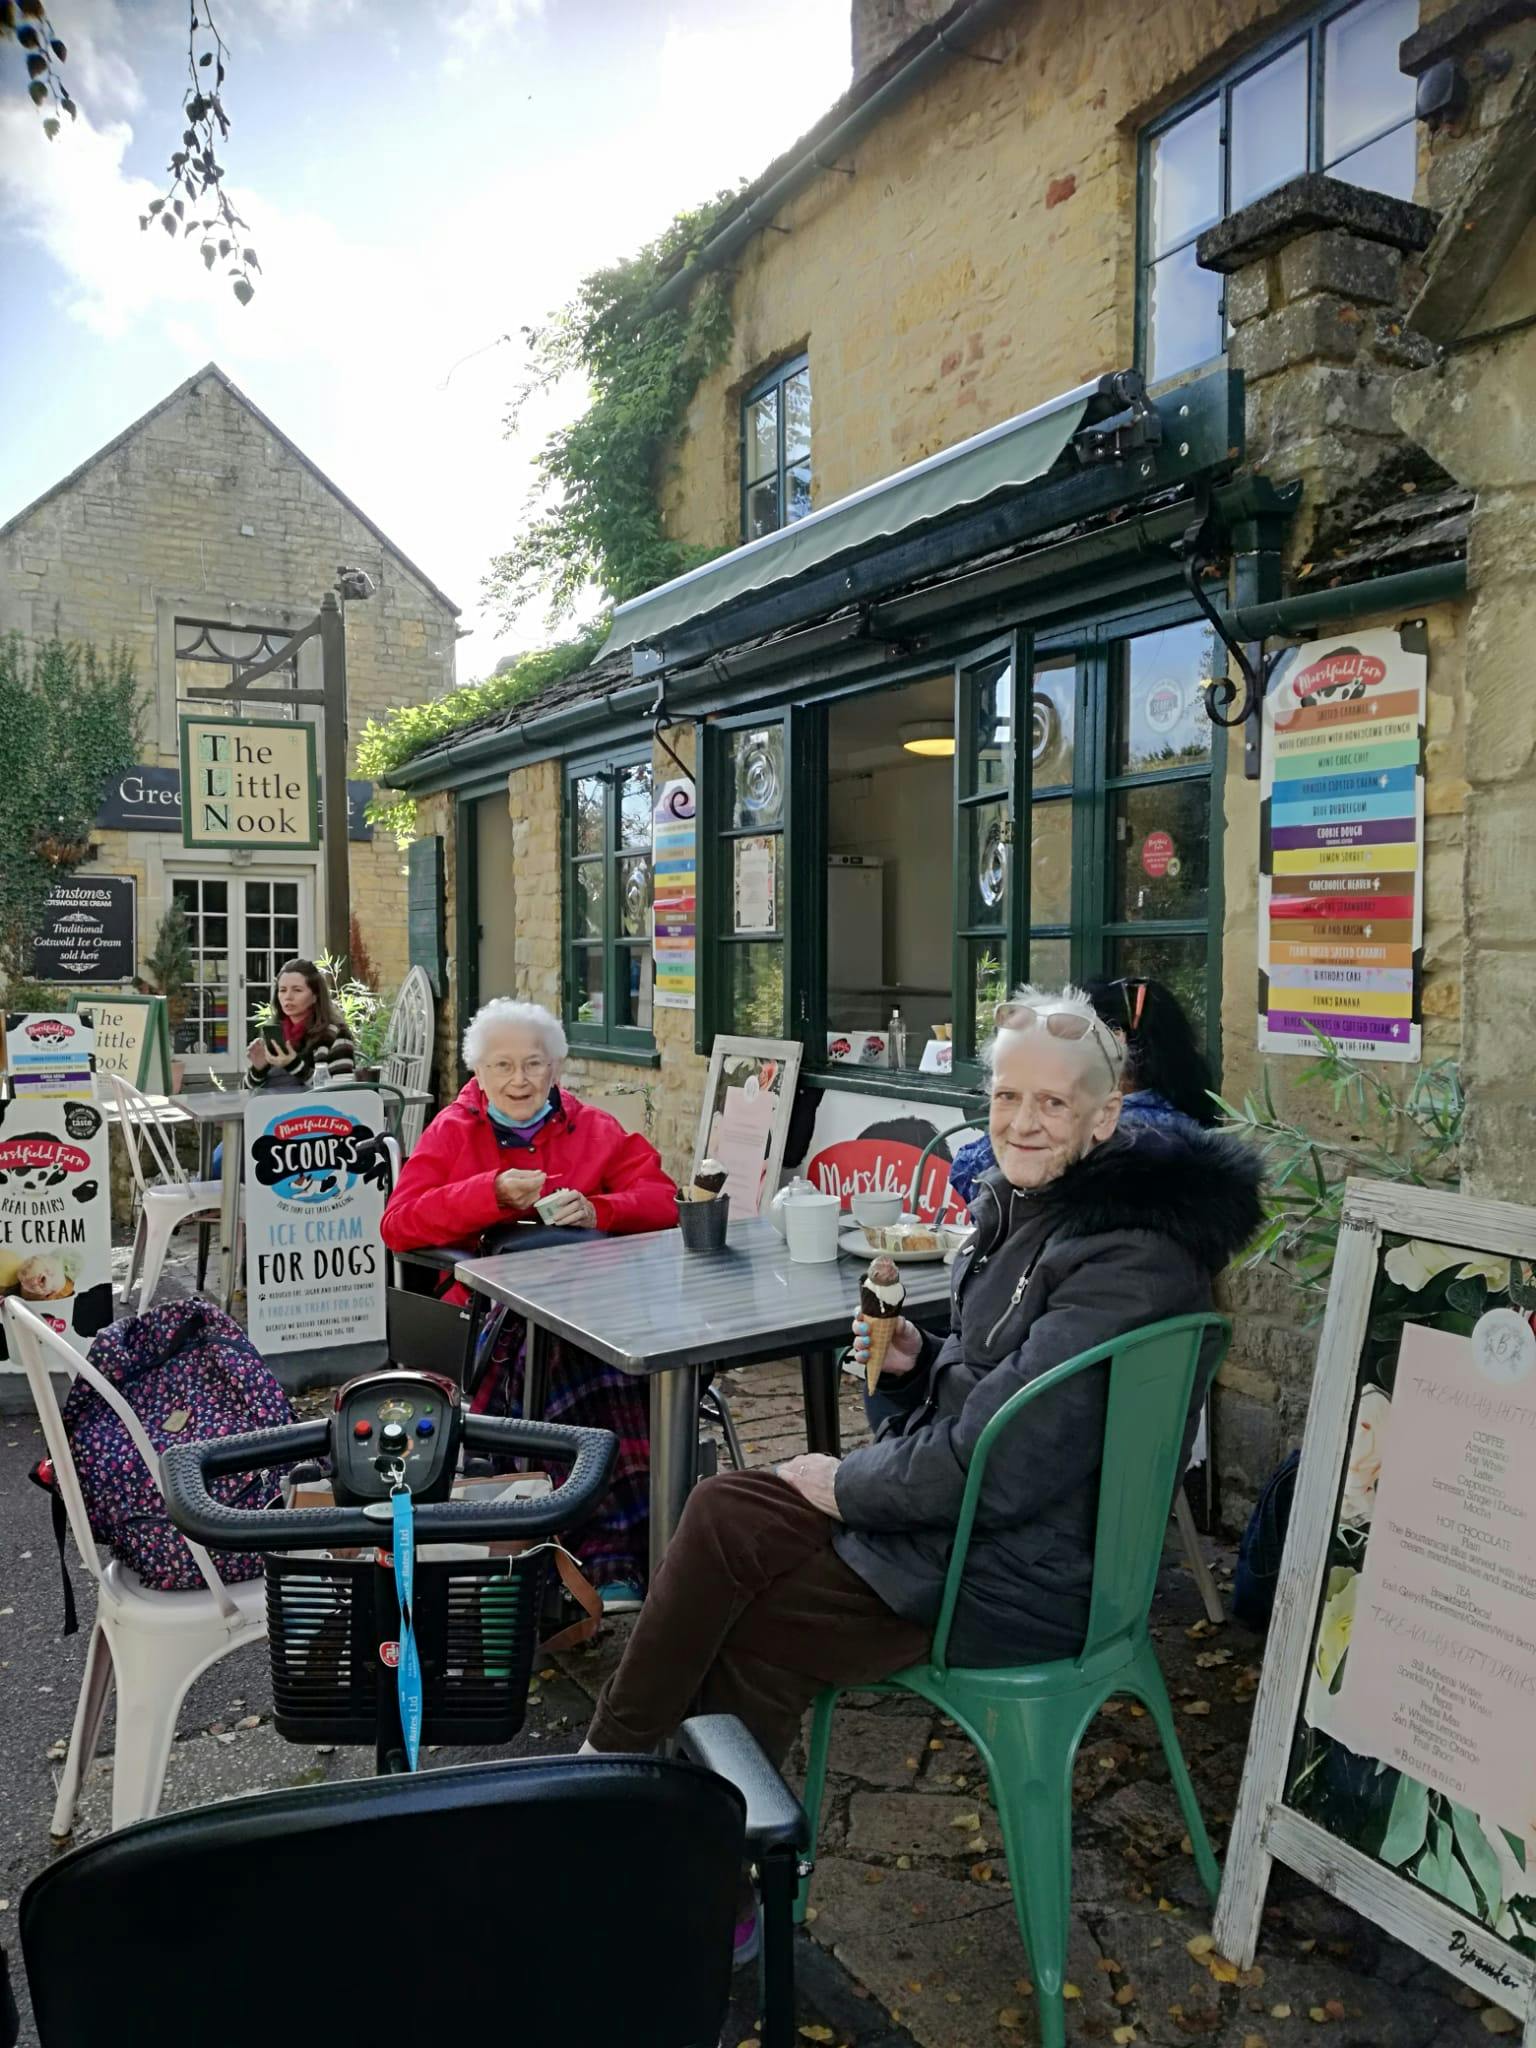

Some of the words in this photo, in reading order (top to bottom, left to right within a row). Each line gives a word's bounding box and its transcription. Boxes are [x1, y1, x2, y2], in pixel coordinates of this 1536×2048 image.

[1357, 659, 1381, 678] Farm
[1329, 730, 1344, 744] WITH
[1384, 721, 1410, 737] CRUNCH
[202, 734, 272, 764] The
[1318, 756, 1333, 768] MINT
[1336, 754, 1352, 766] CHOC
[1354, 752, 1369, 764] CHIP
[119, 776, 182, 806] Gree
[206, 768, 300, 800] Little
[1330, 801, 1367, 816] BUBBLEGUM
[204, 804, 296, 833] Nook
[1317, 826, 1339, 838] COOKIE
[1340, 825, 1363, 837] DOUGH
[52, 923, 104, 934] Traditional
[34, 936, 74, 946] Cotswold
[77, 938, 91, 946] Ice
[93, 938, 122, 946] Cream
[60, 950, 78, 960] sold
[80, 950, 100, 960] here
[1314, 970, 1344, 982] BIRTHDAY
[1346, 971, 1361, 982] CAKE
[1335, 997, 1360, 1008] BANANA
[97, 1032, 136, 1048] ittle
[1358, 1042, 1376, 1051] FARM
[96, 1053, 128, 1070] ook
[280, 1118, 328, 1138] Marshfield
[330, 1118, 349, 1131] Farm
[56, 1146, 84, 1167] Farm
[270, 1136, 358, 1173] SCOOP'S
[2, 1198, 26, 1216] REAL
[32, 1197, 65, 1216] DAIRY
[22, 1218, 86, 1244] CREAM
[270, 1223, 296, 1246] ICE
[305, 1216, 363, 1244] CREAM
[258, 1252, 304, 1285] FOR
[314, 1244, 375, 1279] DOGS
[259, 1306, 264, 1320] A
[268, 1304, 301, 1318] FROZEN
[305, 1301, 330, 1312] TREAT
[334, 1299, 349, 1310] FOR
[352, 1296, 375, 1308] DOGS
[1473, 1431, 1504, 1448] COFFEE
[1465, 1440, 1509, 1462] Americano
[1437, 1514, 1454, 1530] HOT
[1457, 1523, 1512, 1551] CHOCOLATE
[1461, 1537, 1480, 1552] Plain
[1482, 1570, 1499, 1585] and
[1456, 1583, 1471, 1598] TEA
[1426, 1664, 1456, 1688] Mineral
[1392, 1712, 1406, 1727] San
